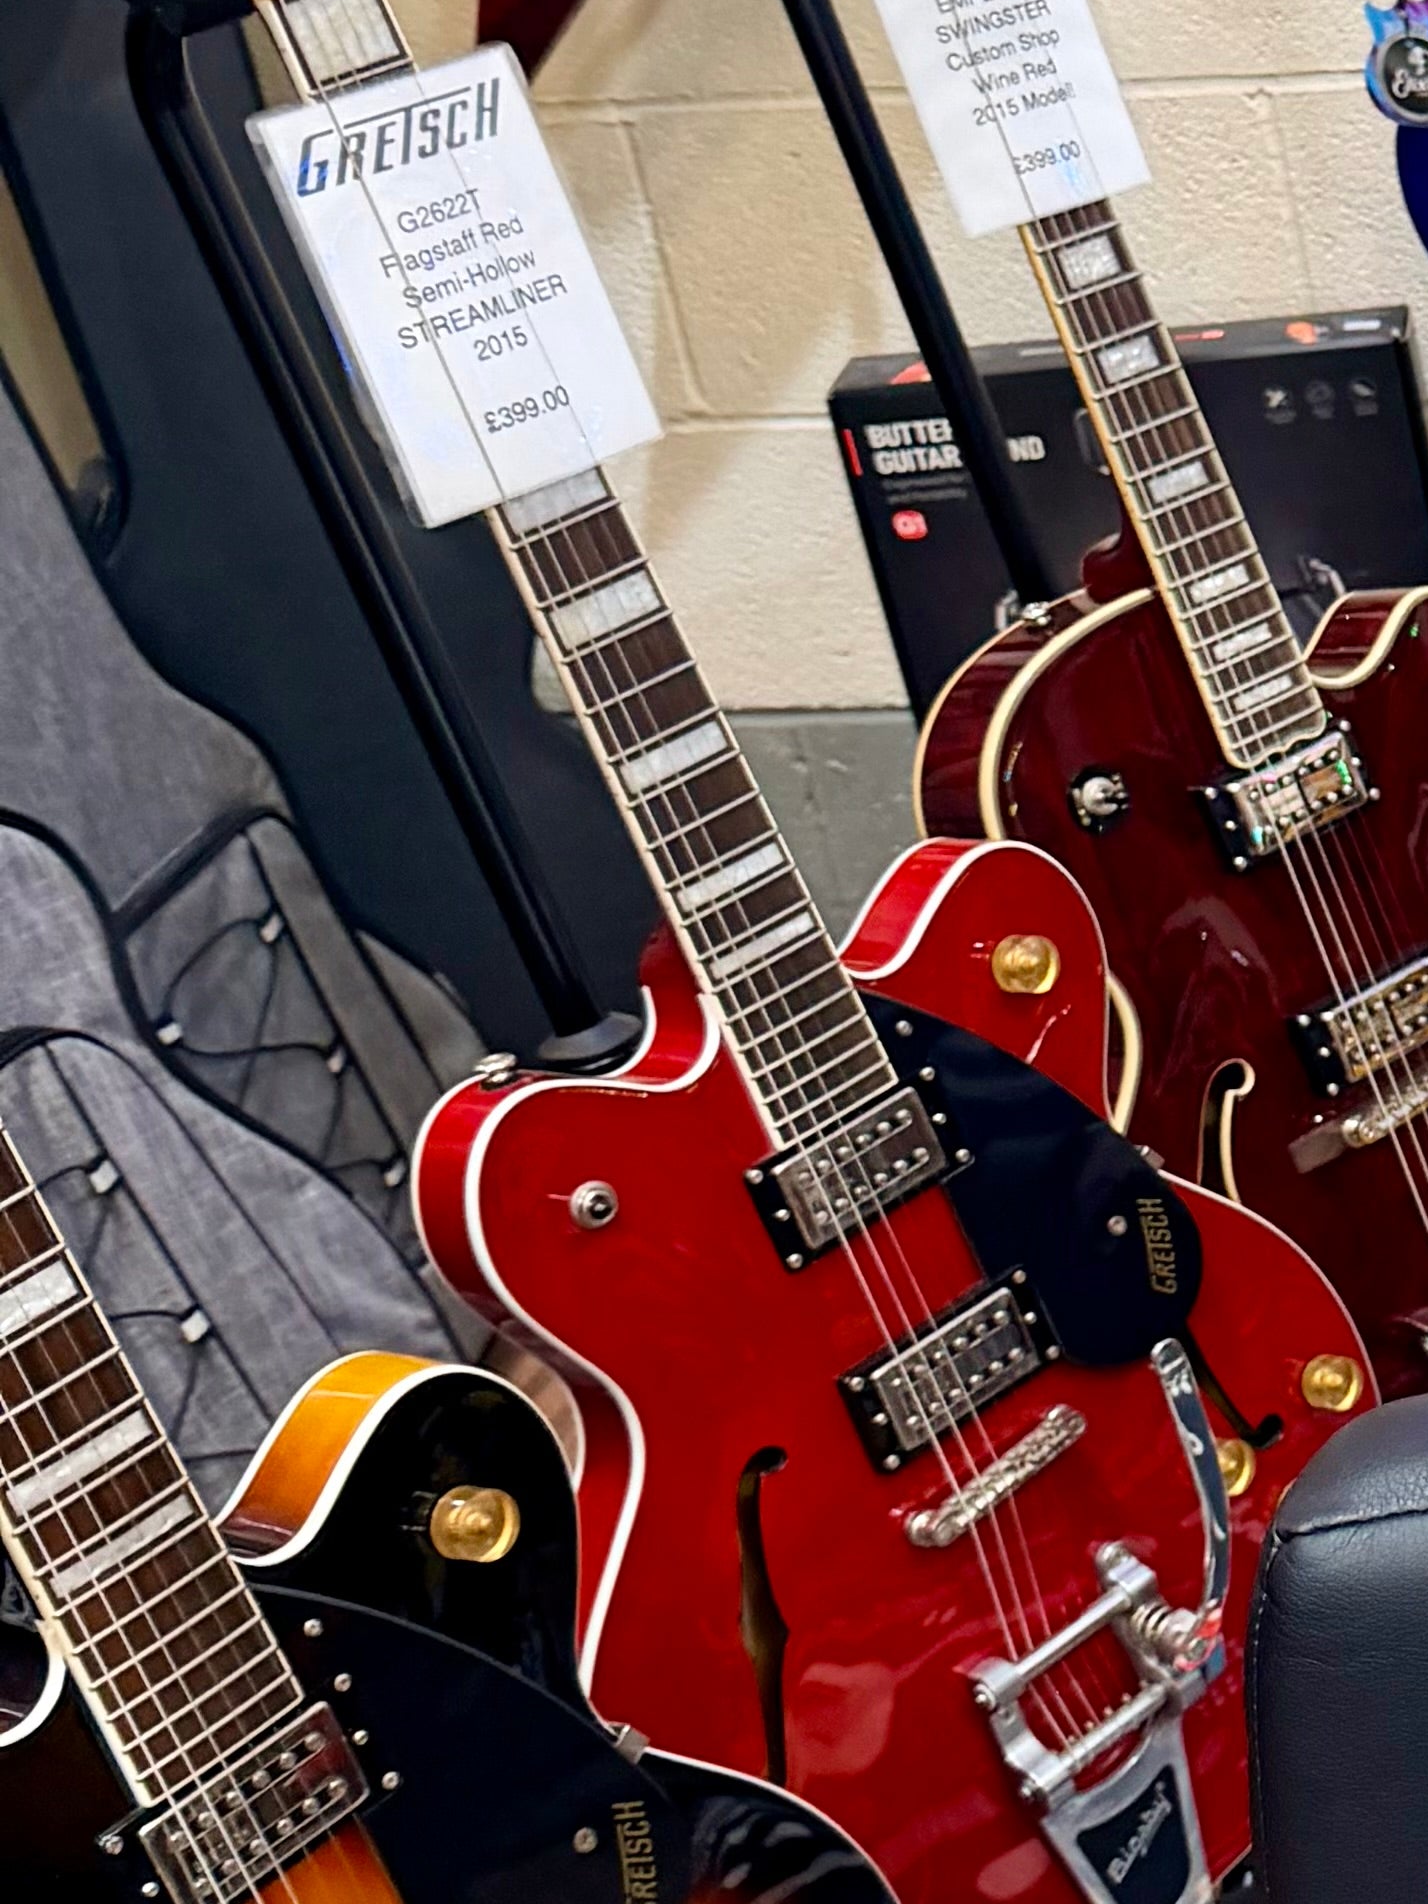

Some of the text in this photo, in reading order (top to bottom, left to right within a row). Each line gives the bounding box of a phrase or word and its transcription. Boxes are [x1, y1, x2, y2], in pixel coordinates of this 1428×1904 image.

[946, 29, 1061, 71] Custom Shop
[972, 58, 1057, 95] Wine Red
[973, 100, 1020, 127] 2015
[297, 77, 500, 197] GRETSCH
[1013, 139, 1081, 176] £399.00
[397, 188, 480, 233] G2622T
[379, 215, 524, 278] Flagstaff Red
[402, 249, 536, 310] Semi-Hollow
[397, 274, 568, 350] STREAMLINER
[473, 326, 529, 362] 2015
[484, 385, 571, 434] £399.00
[872, 444, 963, 475] GUITAR
[1136, 1198, 1178, 1294] GRETSCH
